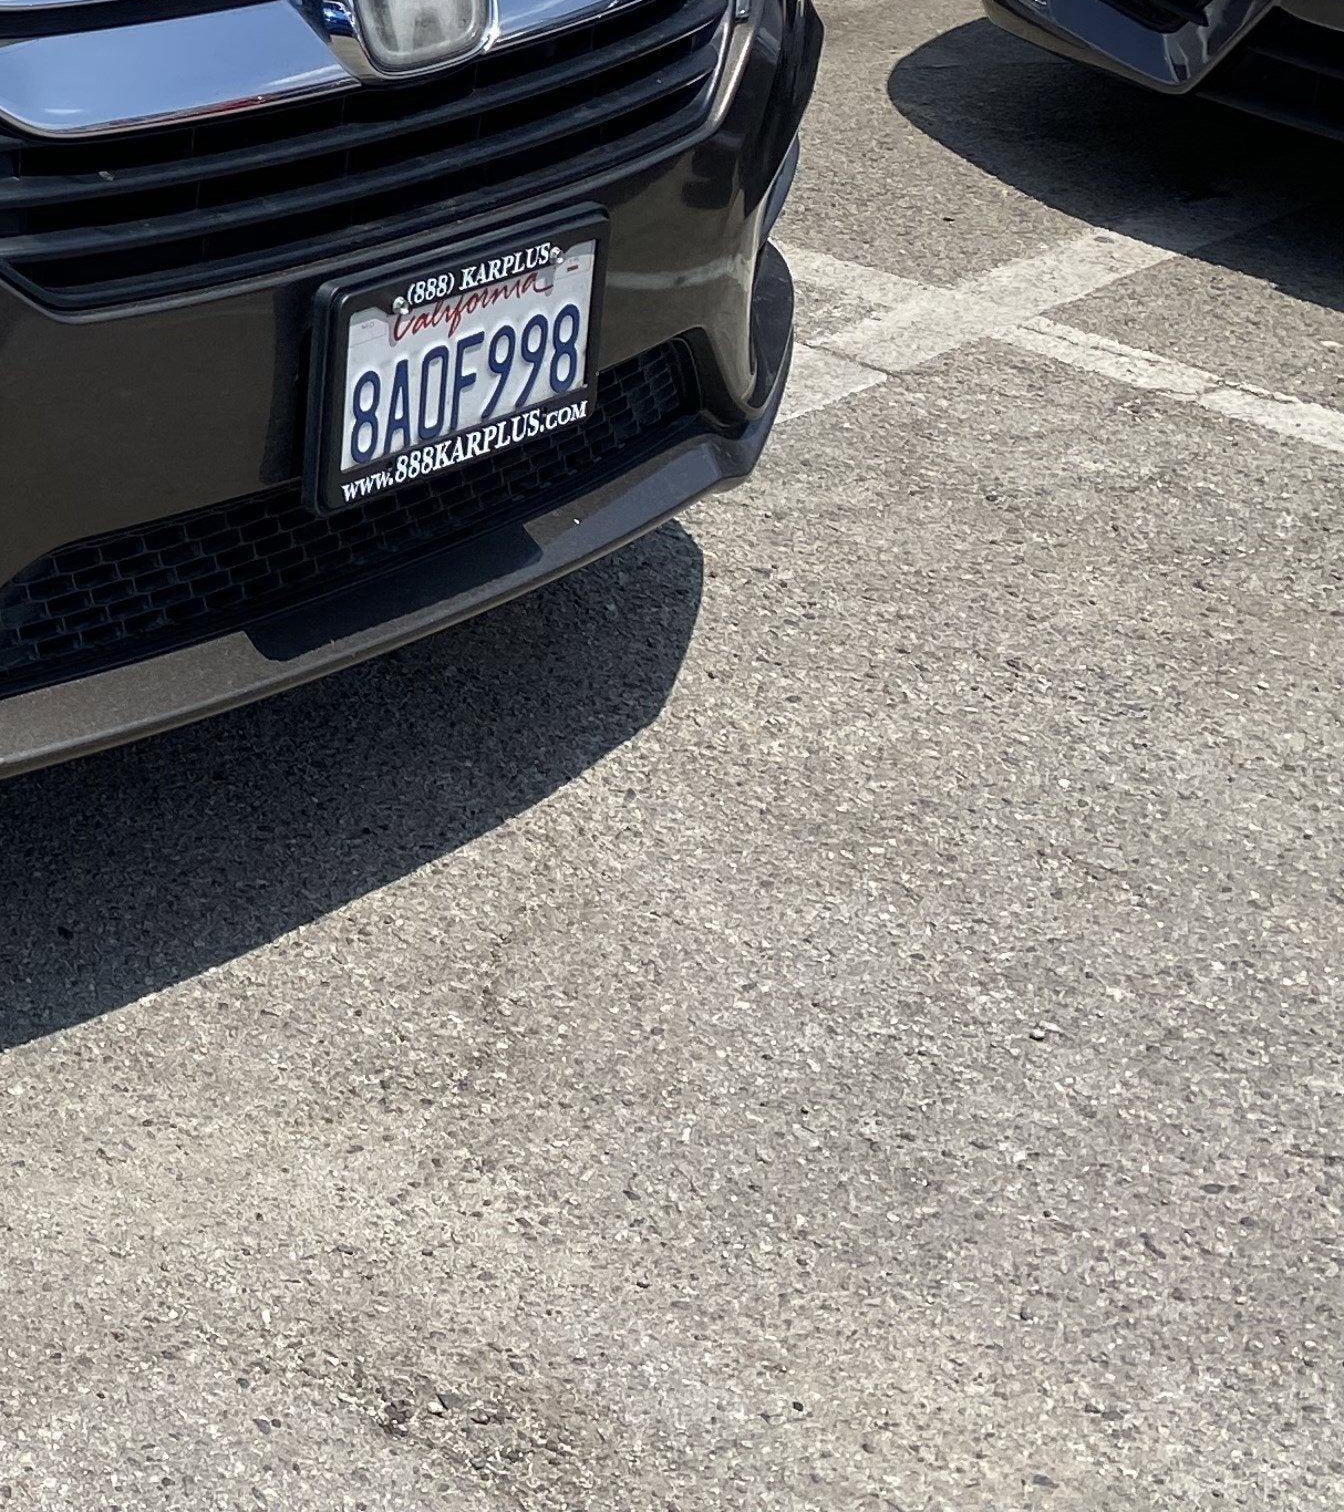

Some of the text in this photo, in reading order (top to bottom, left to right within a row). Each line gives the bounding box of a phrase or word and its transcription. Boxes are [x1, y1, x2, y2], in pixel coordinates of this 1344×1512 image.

[393, 272, 554, 342] California
[406, 242, 551, 306] (888) KARPLUS
